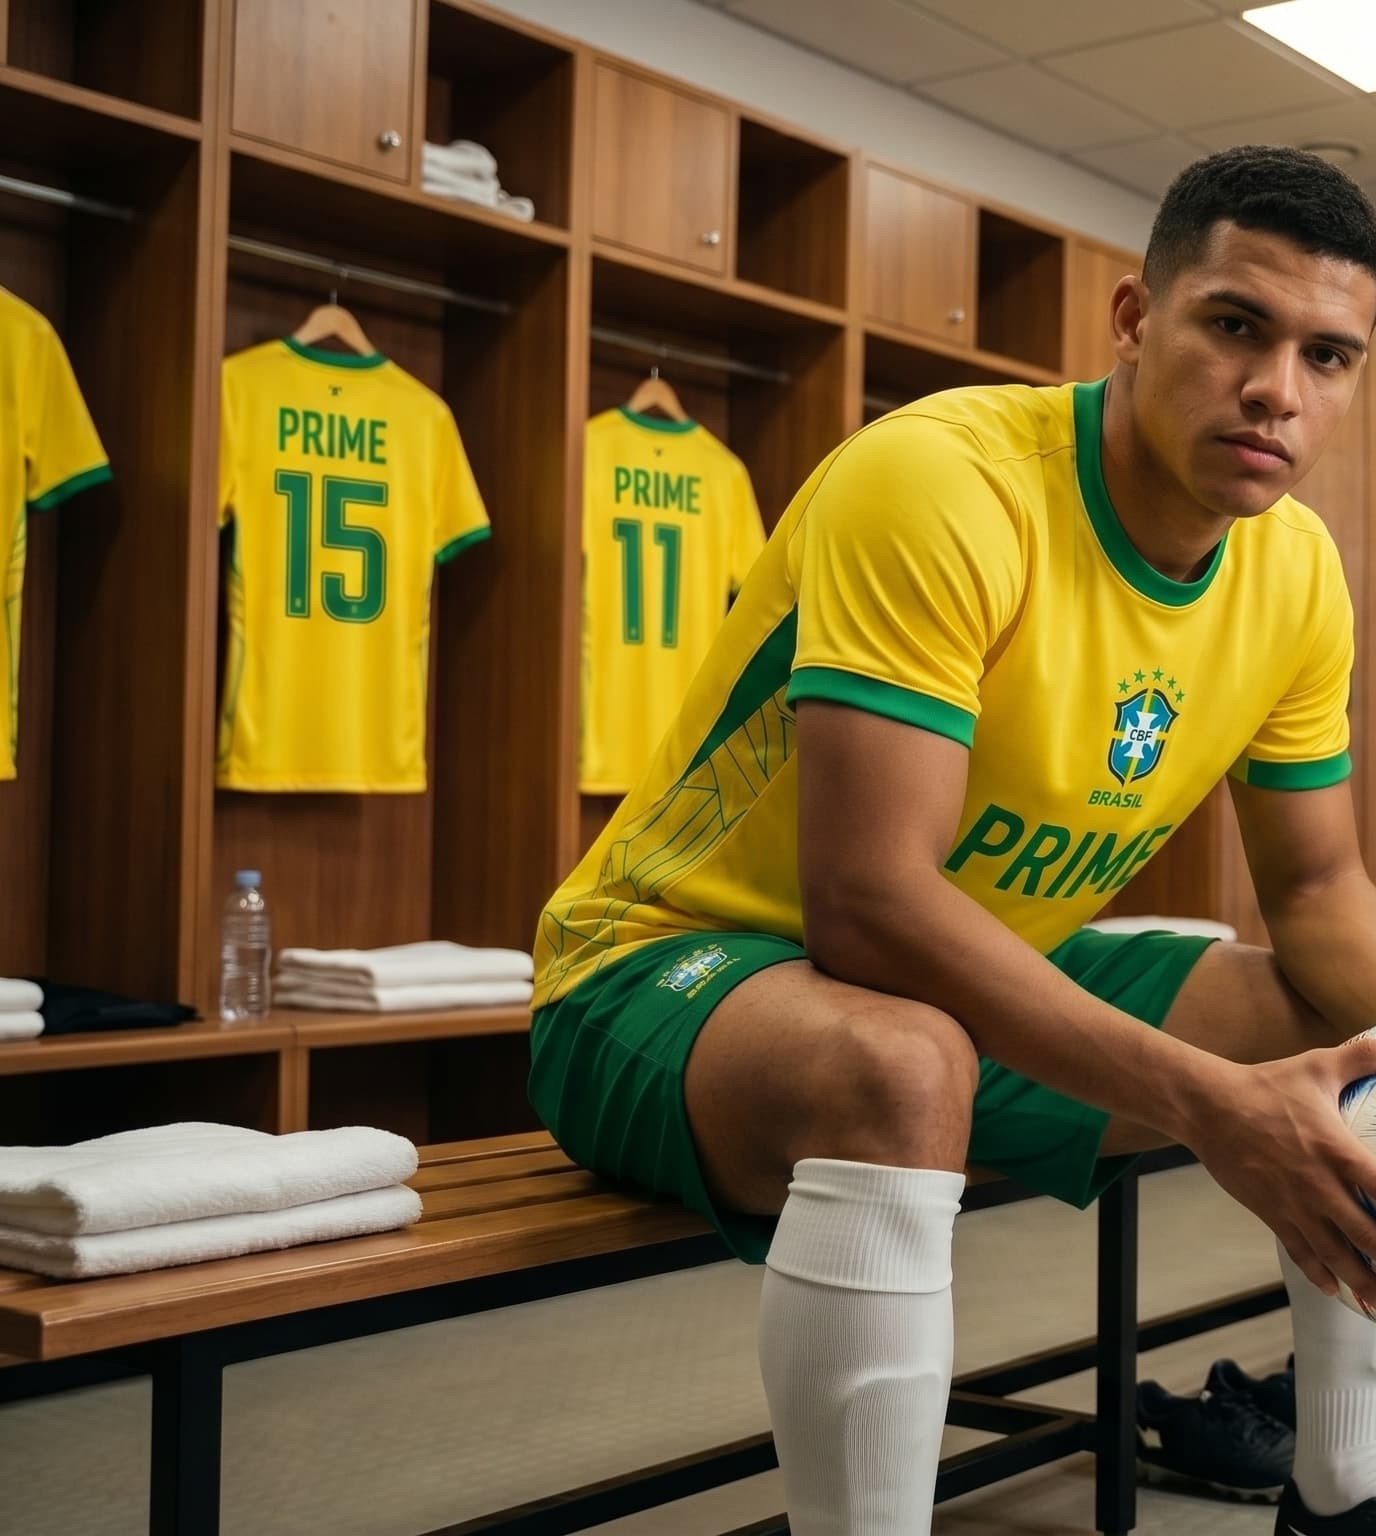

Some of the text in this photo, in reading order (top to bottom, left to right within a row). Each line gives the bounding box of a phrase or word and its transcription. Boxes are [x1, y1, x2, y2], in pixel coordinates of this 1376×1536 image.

[277, 406, 387, 465] PRIME
[614, 466, 702, 515] PRIME
[274, 468, 388, 624] 15
[613, 517, 682, 649] 11
[1129, 728, 1153, 742] CBF
[1087, 789, 1143, 809] BRASIL
[943, 803, 1174, 899] PRIME
